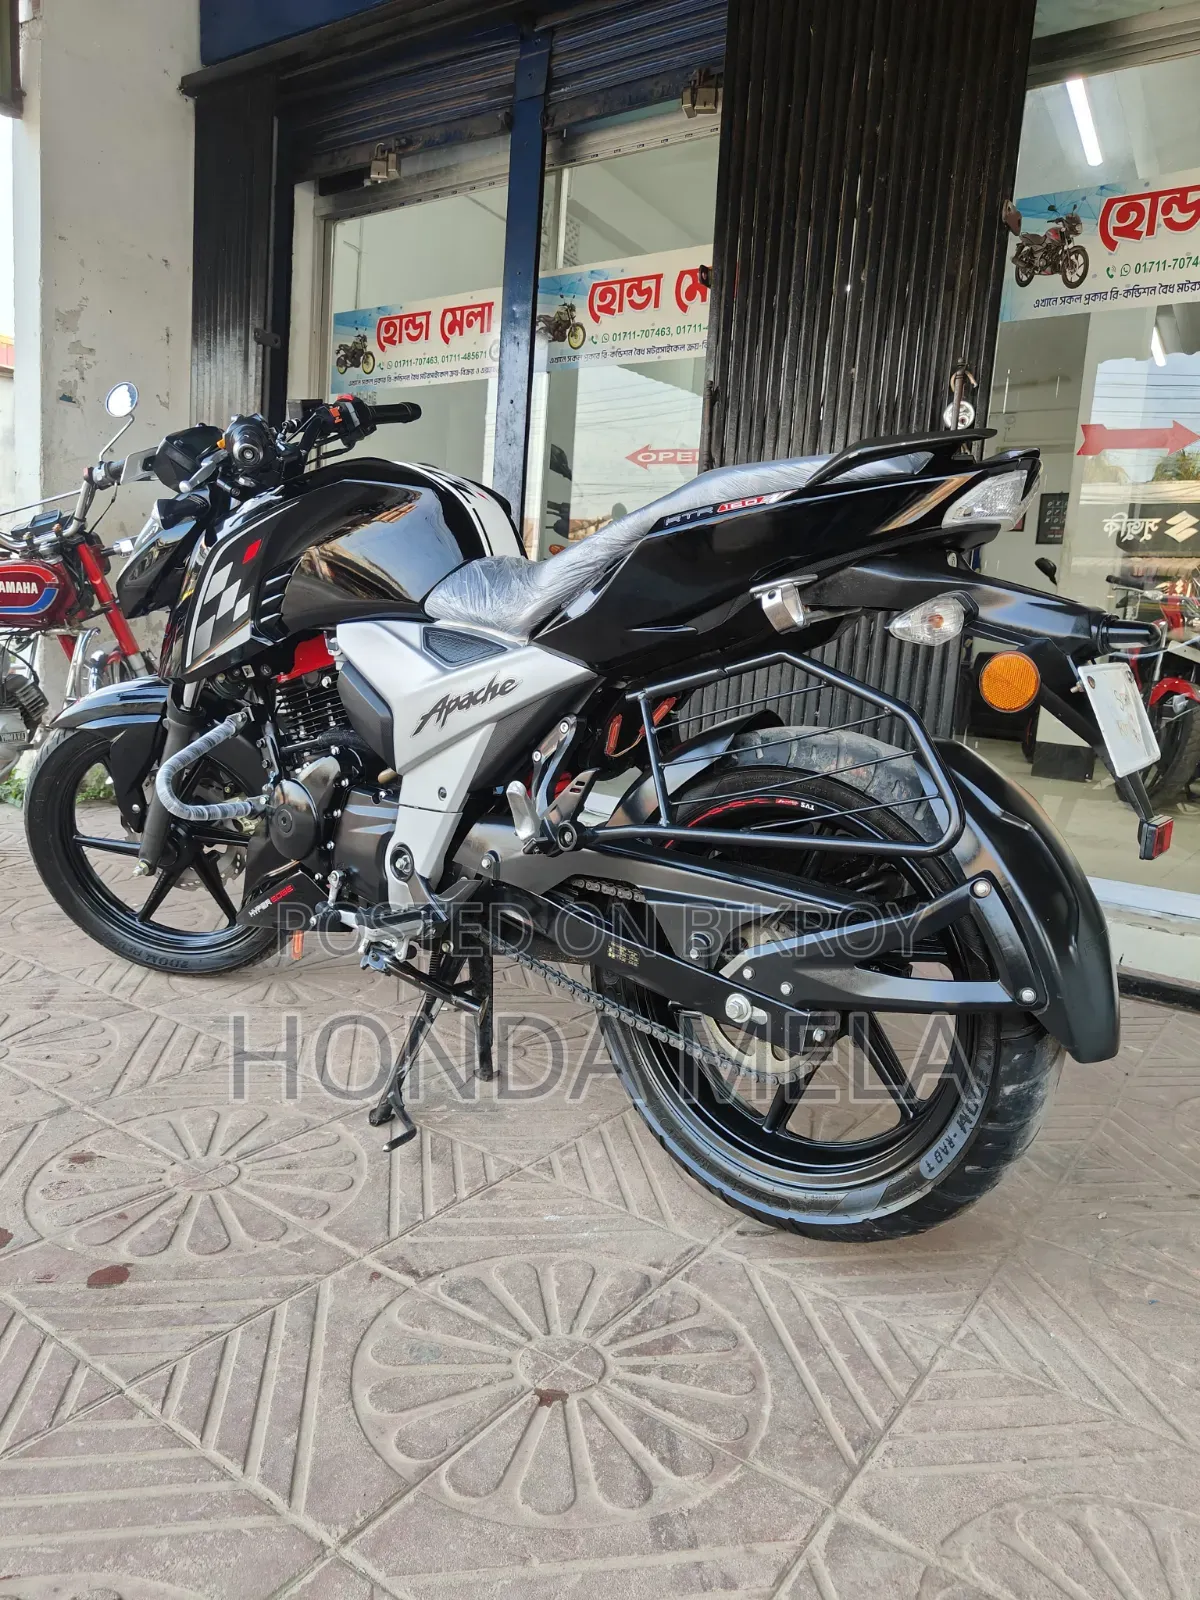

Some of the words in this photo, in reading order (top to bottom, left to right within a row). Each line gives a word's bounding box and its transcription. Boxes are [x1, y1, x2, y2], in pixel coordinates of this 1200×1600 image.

[1099, 184, 1200, 252] হোন্ড
[1134, 255, 1200, 275] 01711-7074
[588, 273, 663, 324] হোন্ডা
[1033, 297, 1058, 308] এখানে
[1059, 294, 1082, 305] সকল
[1083, 291, 1108, 305] প্রকার
[376, 310, 431, 353] হোন্ডা
[440, 301, 494, 345] মেলা
[675, 322, 709, 336] 01711-
[637, 451, 699, 463] OPE
[665, 505, 714, 527] RTR
[0, 580, 39, 595] AMAHA
[411, 671, 521, 737] Apache
